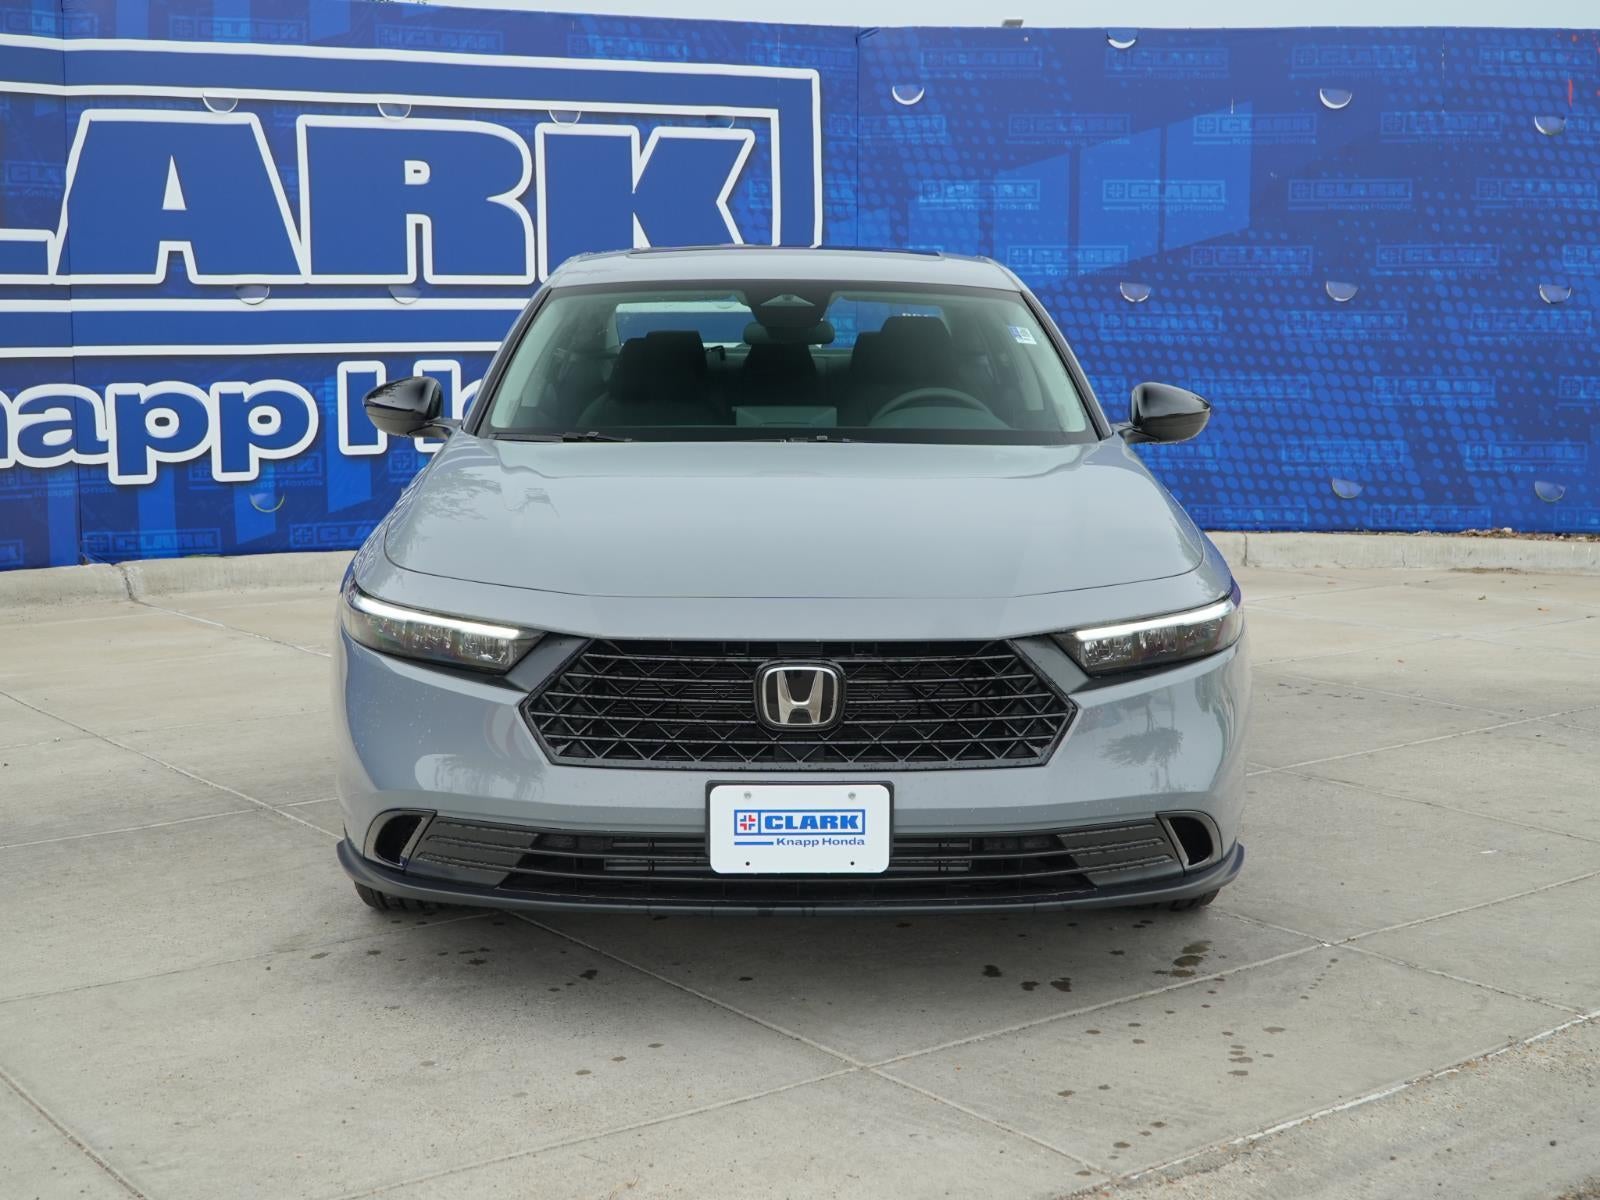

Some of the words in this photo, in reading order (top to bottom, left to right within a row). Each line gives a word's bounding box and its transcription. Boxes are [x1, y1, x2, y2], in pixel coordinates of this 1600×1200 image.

[0, 108, 756, 286] ARK
[765, 815, 859, 830] CLARK
[776, 838, 819, 848] Knapp
[822, 837, 866, 846] Honda
